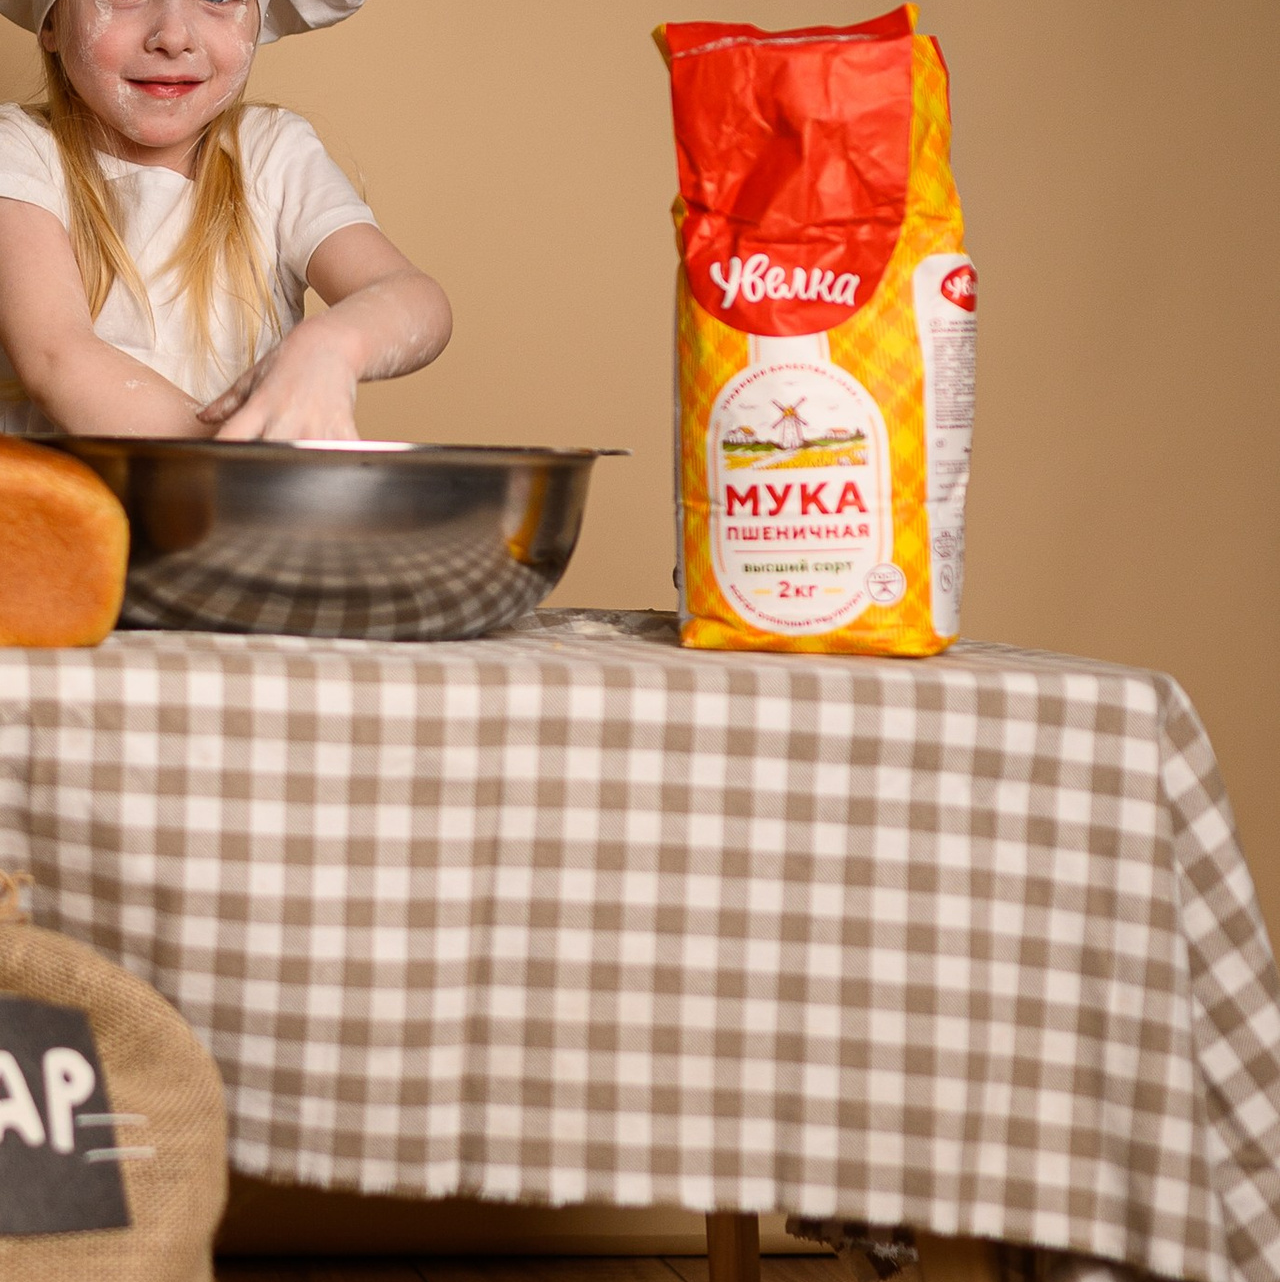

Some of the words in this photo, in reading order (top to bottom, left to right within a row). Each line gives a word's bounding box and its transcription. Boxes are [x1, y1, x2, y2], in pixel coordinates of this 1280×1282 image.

[709, 253, 861, 310] Увелка
[725, 480, 868, 517] МУКА
[726, 522, 870, 541] ПШЕНИЧНАЯ
[743, 559, 810, 573] высший
[814, 561, 854, 577] сорт
